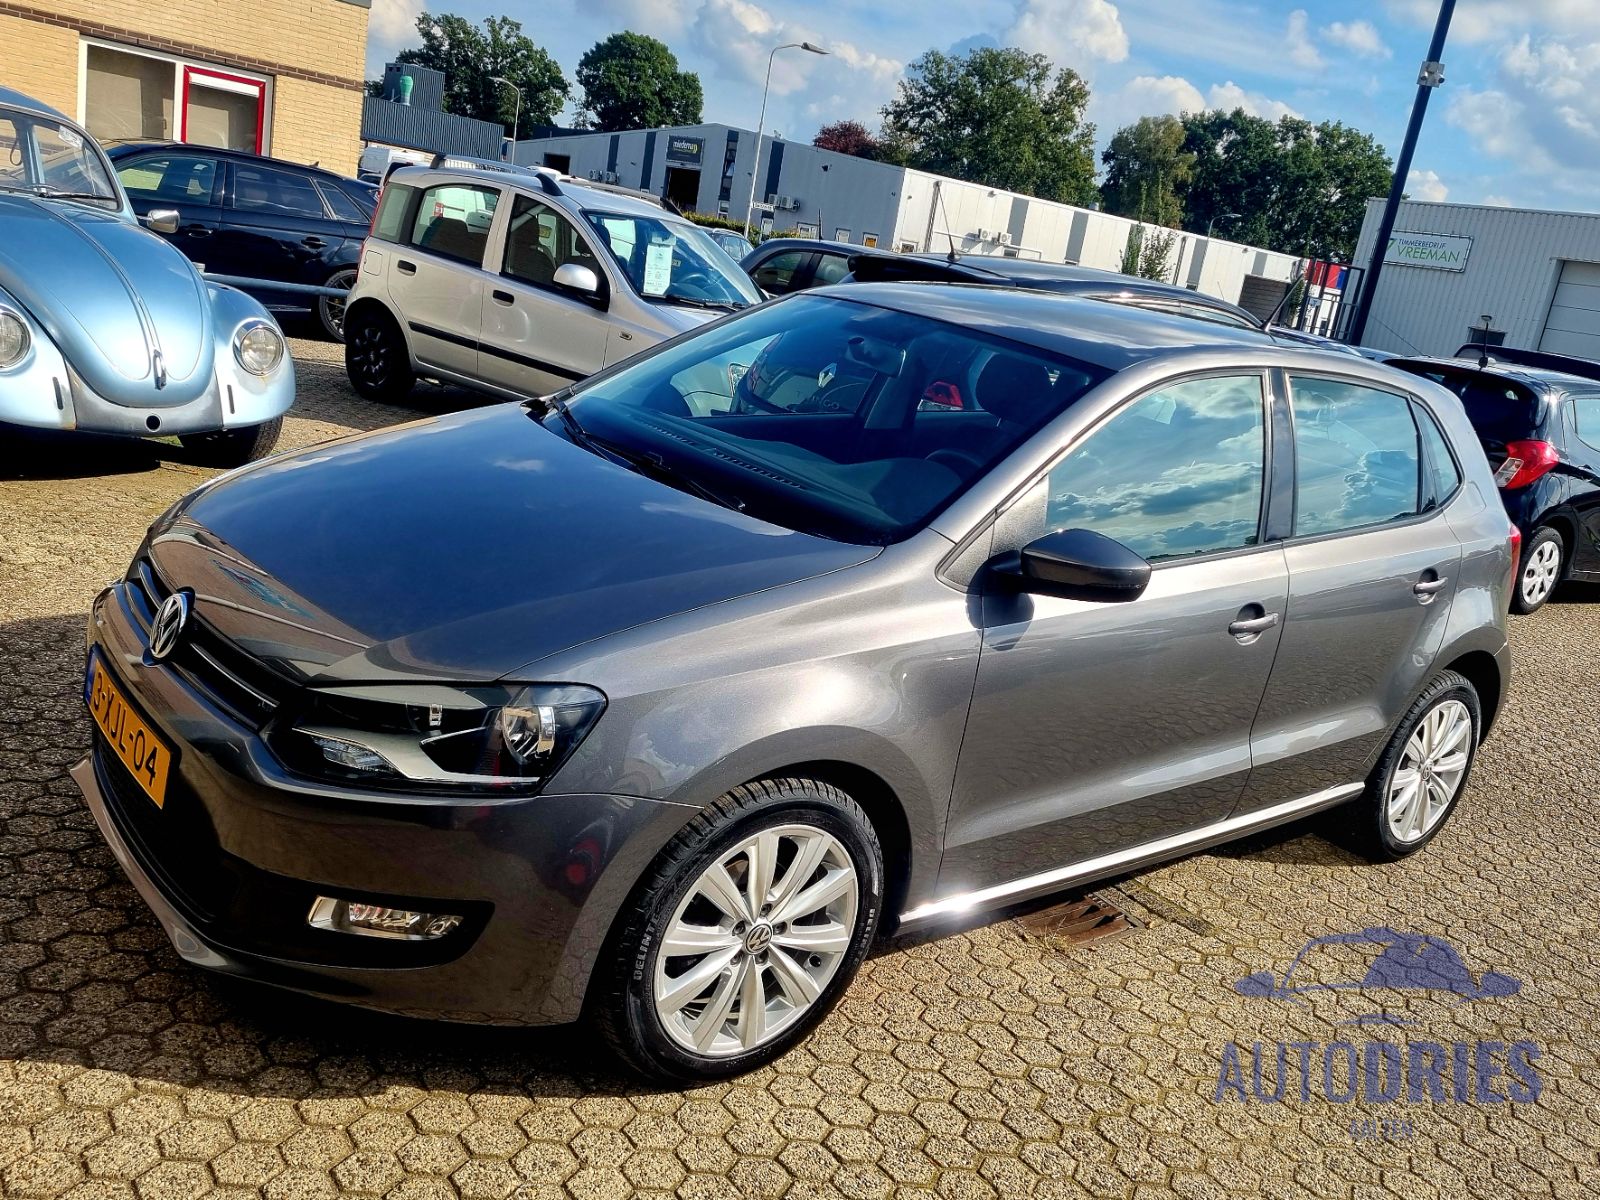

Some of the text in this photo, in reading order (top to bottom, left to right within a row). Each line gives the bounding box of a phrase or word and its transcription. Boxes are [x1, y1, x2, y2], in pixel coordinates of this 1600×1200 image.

[1398, 239, 1447, 250] TIMMERBEDRIJF
[1397, 245, 1460, 263] VREEMAN
[93, 671, 158, 788] 3-XJL-04
